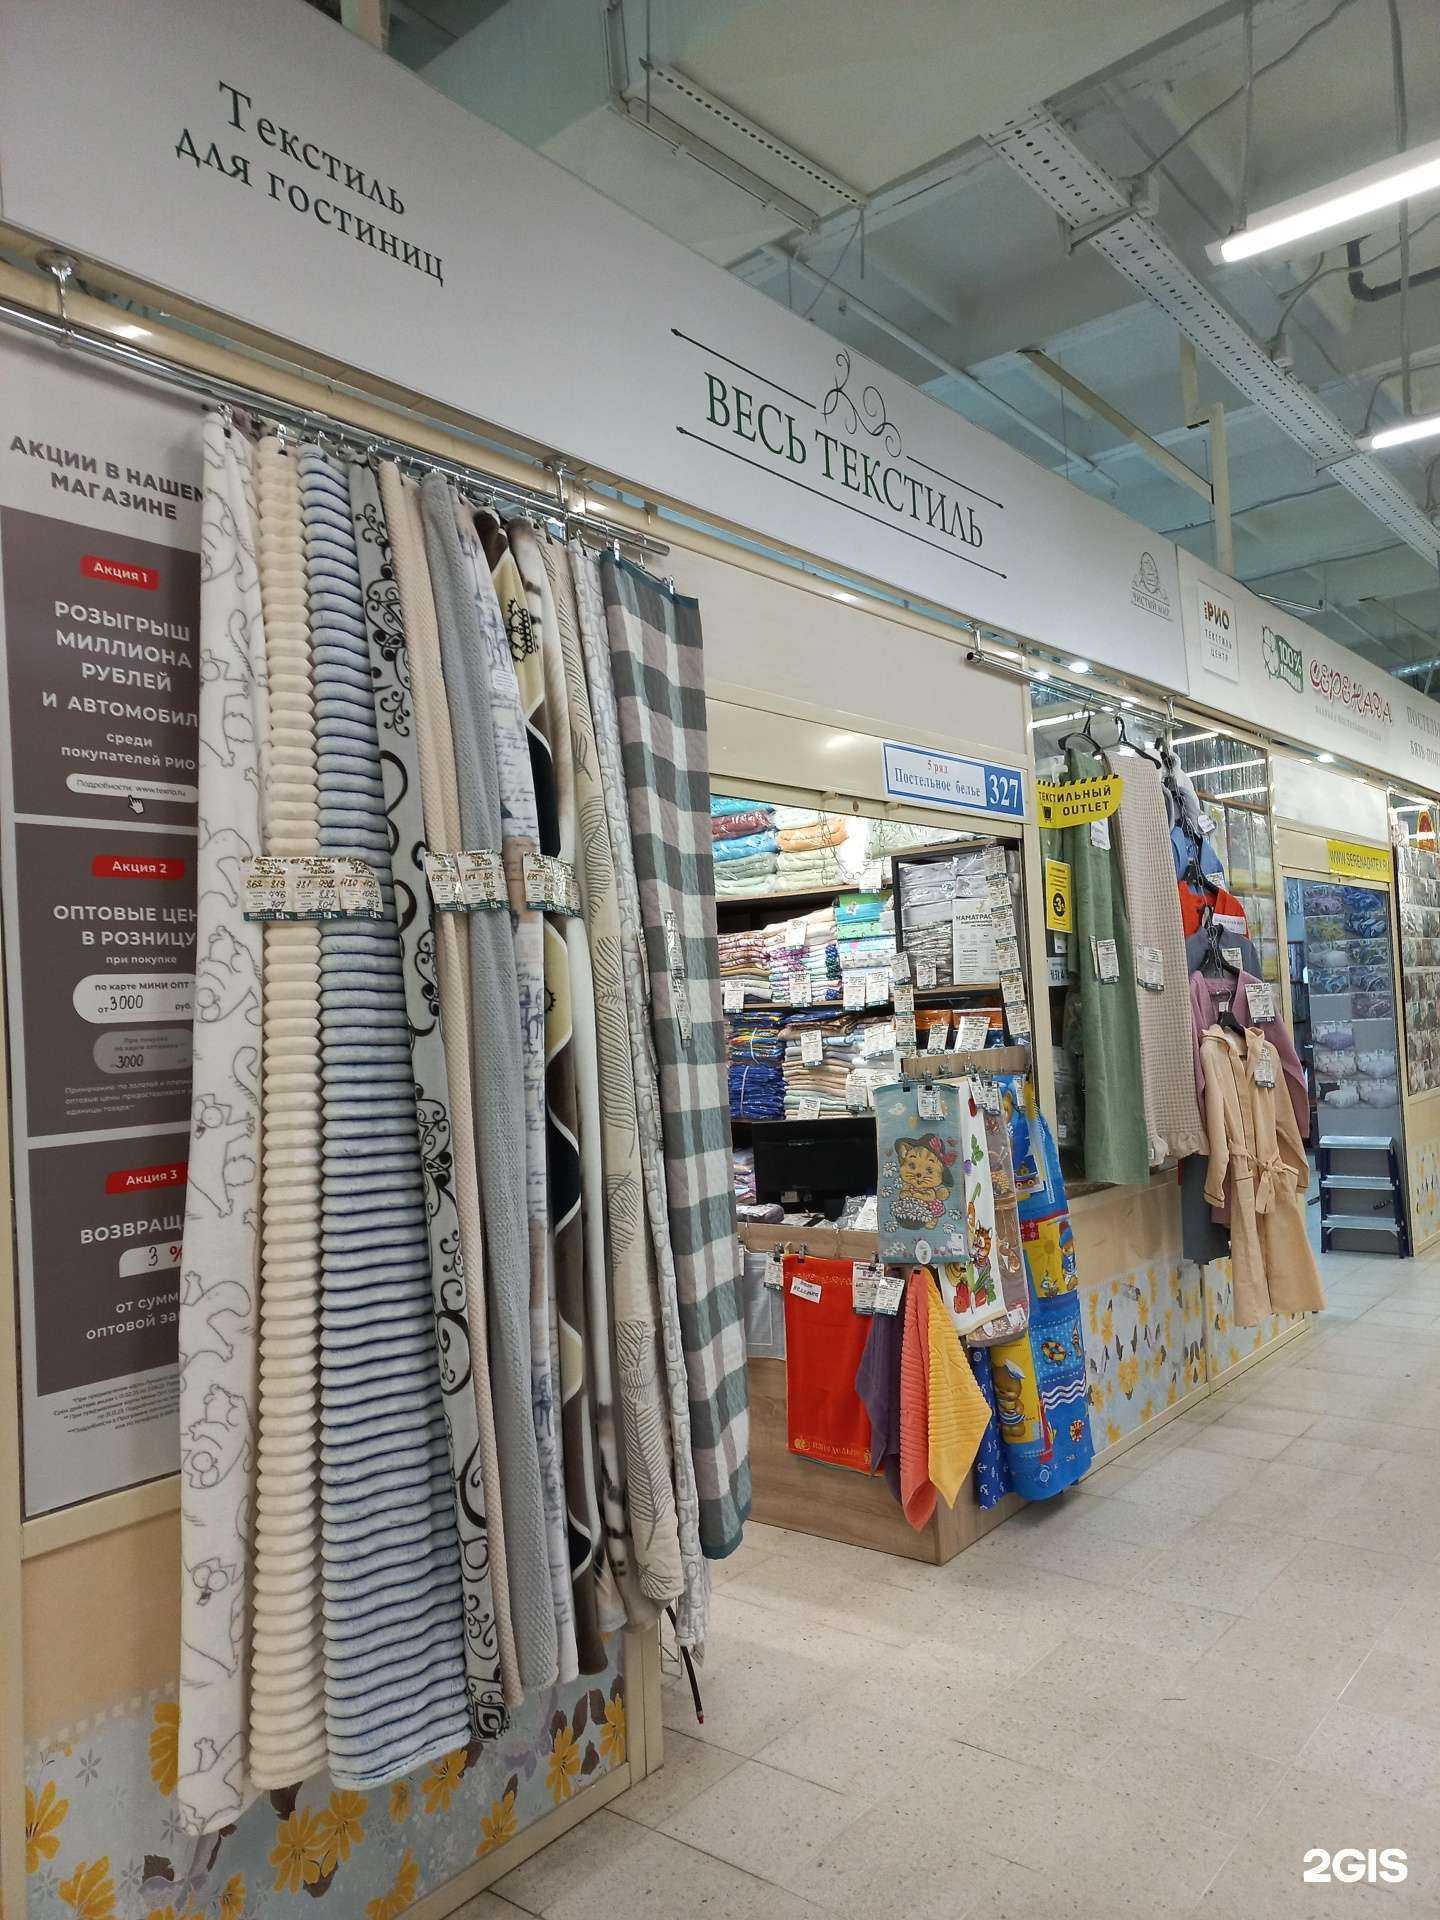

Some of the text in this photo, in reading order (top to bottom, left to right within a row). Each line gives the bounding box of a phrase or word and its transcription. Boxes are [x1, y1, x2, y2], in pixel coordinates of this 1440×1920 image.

[219, 80, 405, 215] Текстиль
[175, 128, 444, 288] для гостиниц
[10, 434, 98, 476] АКЦИИ
[106, 461, 120, 480] В
[704, 371, 984, 549] ВЕСЬ ТЕКСТИЛЬ
[51, 471, 178, 521] МАГАЗИНЕ
[93, 561, 149, 583] Акция 1
[54, 600, 191, 643] РОЗЫГРЫШ
[56, 629, 192, 669] МИЛЛИОНА
[81, 661, 172, 693] РУБЛЕЙ
[43, 691, 57, 708] И
[106, 732, 153, 748] среди
[61, 745, 196, 771] покупателей РИО
[927, 759, 949, 776] 5 ряд
[894, 767, 981, 798] Постельное белье
[988, 774, 1019, 809] 327
[1038, 785, 1112, 803] ТЕКСТИЛЬНЫЙ
[1062, 800, 1110, 817] OUTLET
[112, 859, 168, 875] Акция 2
[53, 903, 157, 923] ОПТОВЫЕ
[81, 929, 197, 949] В РОЗНИЦУ
[105, 955, 178, 966] при покупке
[109, 983, 137, 992] карте
[138, 982, 169, 990] МИНИ
[98, 1006, 109, 1014] от
[110, 994, 144, 1011] 3000
[116, 1054, 144, 1069] 3000
[126, 1169, 178, 1187] Акция 3
[116, 1300, 135, 1315] от
[86, 1312, 156, 1341] оптовой
